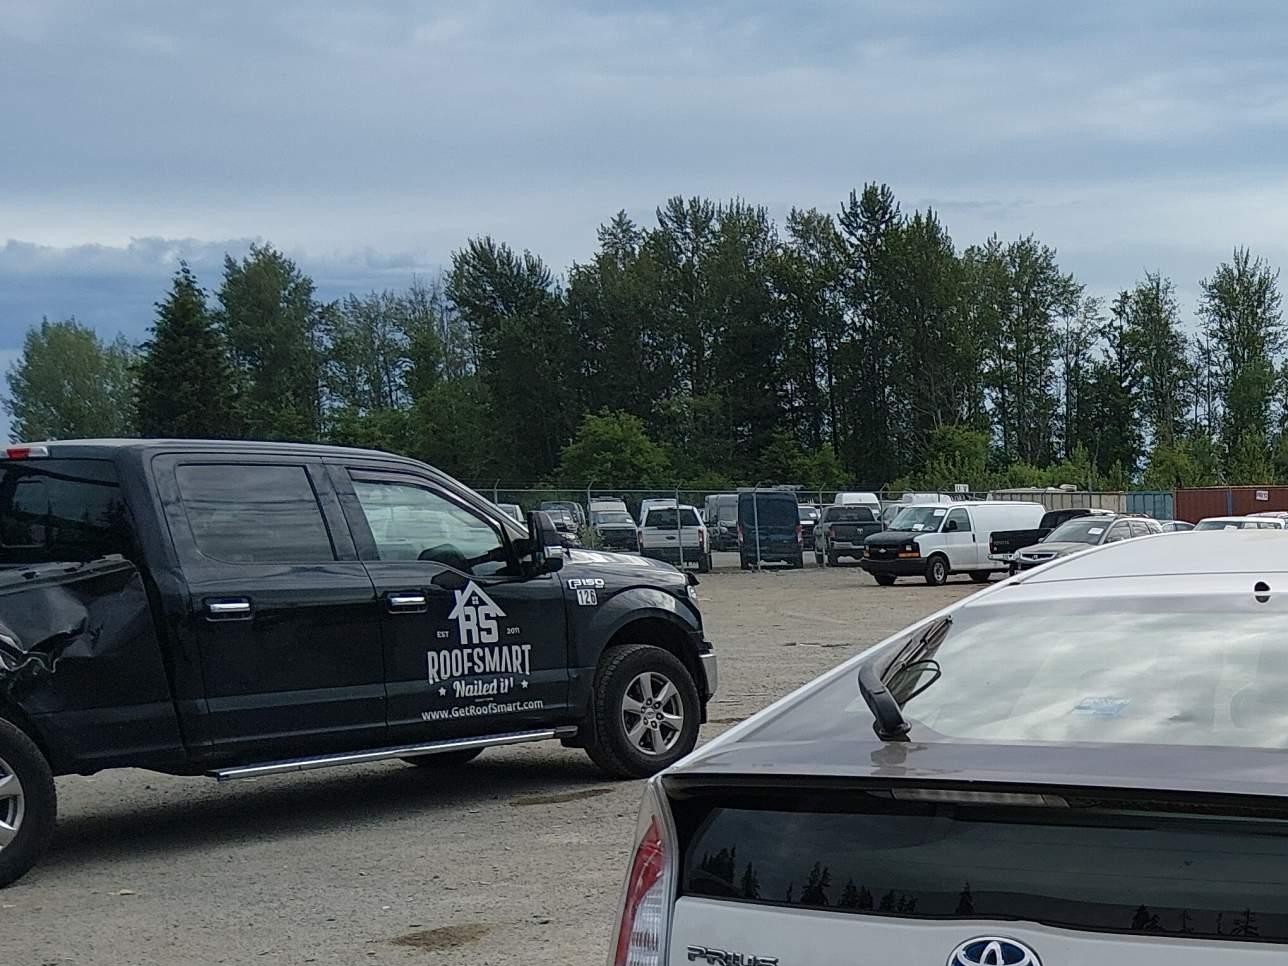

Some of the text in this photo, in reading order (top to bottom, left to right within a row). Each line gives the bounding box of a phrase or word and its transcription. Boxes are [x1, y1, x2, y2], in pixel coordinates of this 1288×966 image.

[578, 590, 597, 605] 126
[436, 630, 449, 639] EST
[457, 604, 499, 645] RS
[427, 644, 532, 685] ROOFSMART
[453, 679, 498, 698] Nailed
[421, 700, 544, 721] www.GetRoofSmart.com
